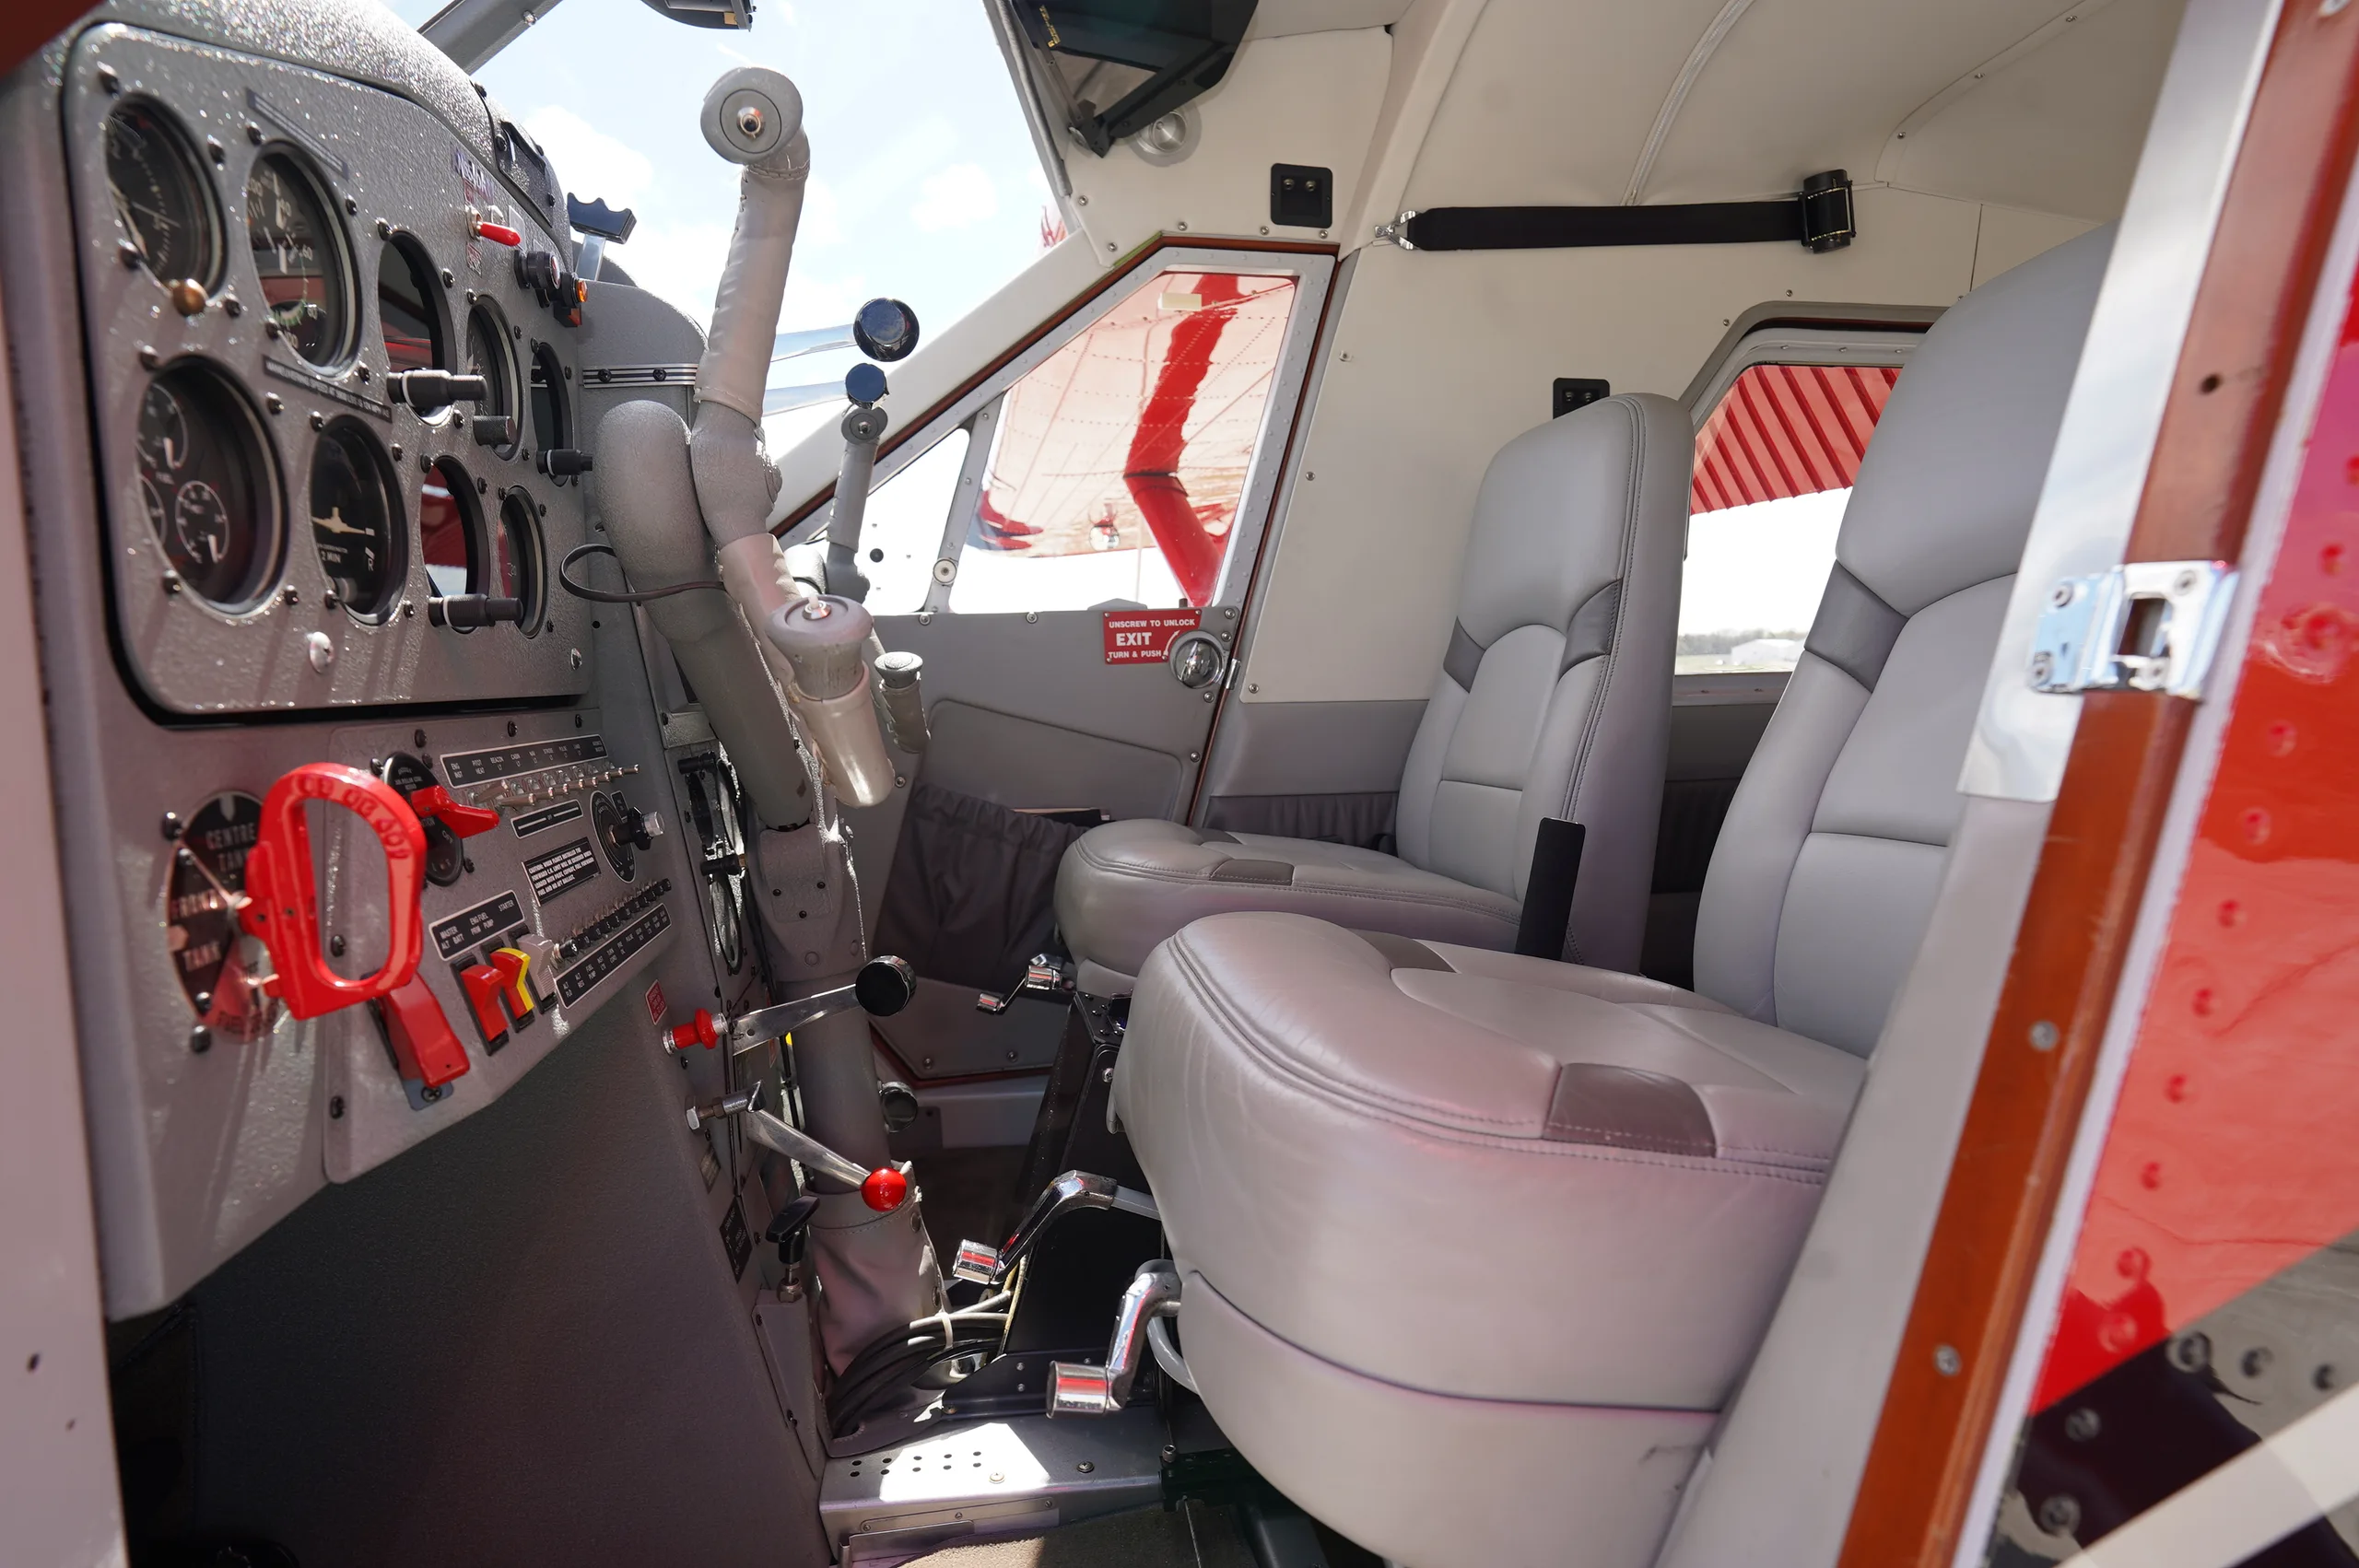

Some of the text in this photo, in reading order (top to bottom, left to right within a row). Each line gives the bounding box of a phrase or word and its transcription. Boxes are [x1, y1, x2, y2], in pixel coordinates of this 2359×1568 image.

[326, 552, 342, 565] MIN
[368, 558, 375, 572] R
[1109, 620, 1147, 628] UNSCREW
[1116, 632, 1153, 647] EXIT
[1109, 650, 1130, 659] TURN
[205, 822, 256, 850] CENTRE
[498, 899, 515, 912] STARTER
[469, 912, 488, 925] ENG FUEL
[483, 919, 494, 930] PUMP
[440, 926, 459, 940] MASTER
[441, 933, 465, 951] ALT BATT
[182, 941, 221, 972] TANK
